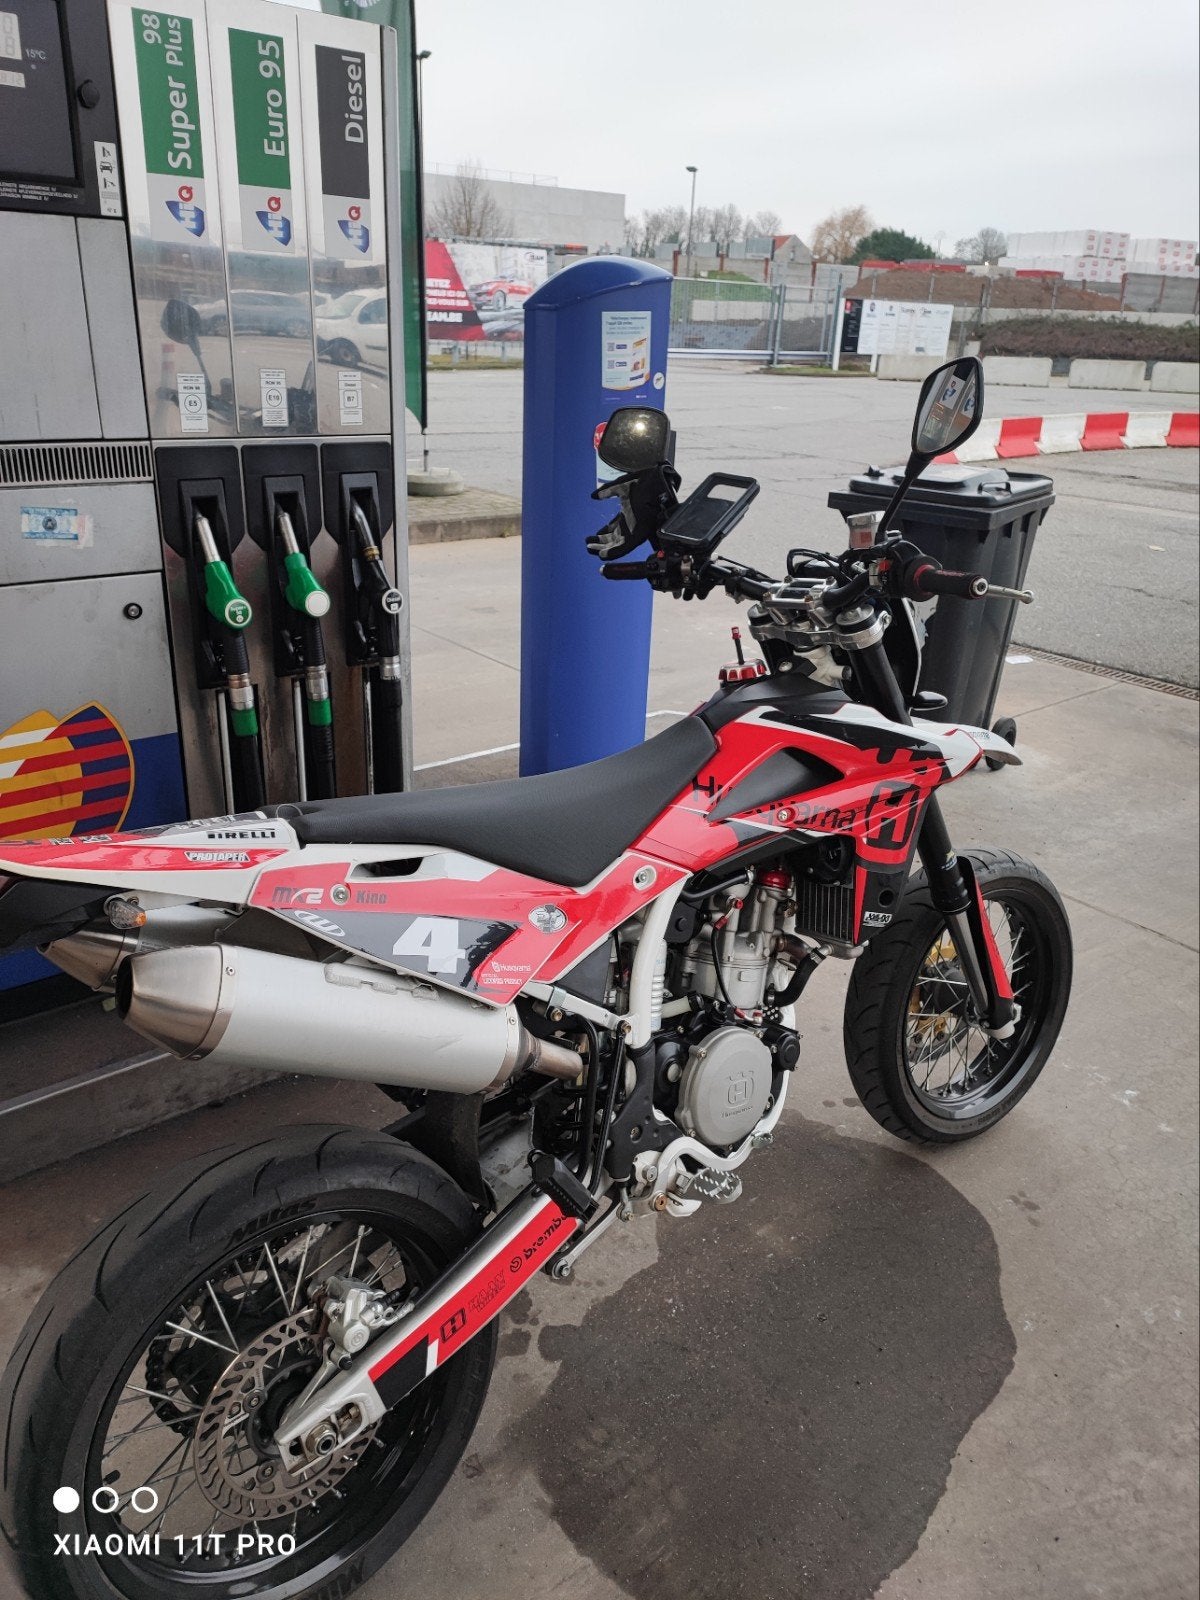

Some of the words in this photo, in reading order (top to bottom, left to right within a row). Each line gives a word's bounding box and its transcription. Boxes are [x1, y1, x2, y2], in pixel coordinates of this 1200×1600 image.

[141, 13, 162, 44] 98
[165, 17, 184, 68] Plus
[259, 39, 281, 79] 95
[167, 75, 196, 170] Super
[263, 89, 286, 157] Euro
[341, 54, 365, 144] Diesel
[393, 917, 465, 973] 4
